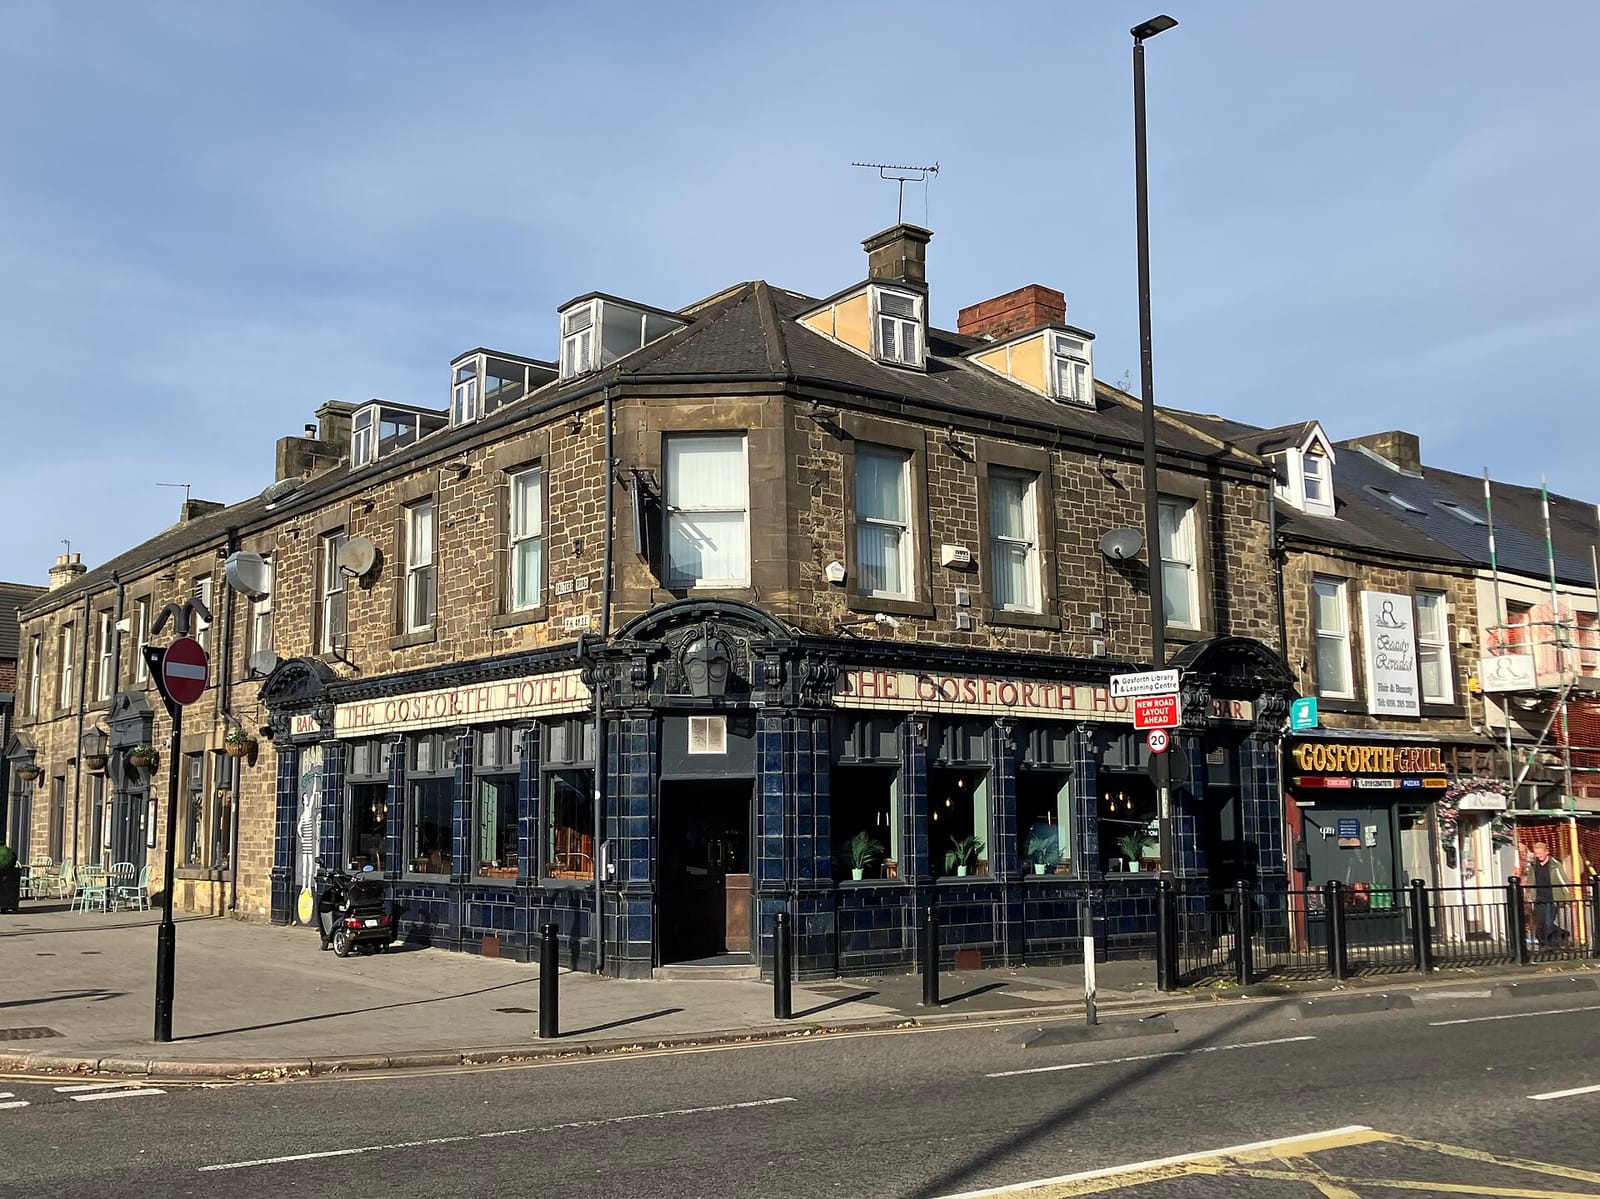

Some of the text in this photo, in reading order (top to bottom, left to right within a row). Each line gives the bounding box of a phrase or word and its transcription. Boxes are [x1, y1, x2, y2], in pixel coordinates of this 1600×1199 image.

[1122, 674, 1174, 685] Gosforth Library
[841, 671, 897, 698] THE
[916, 674, 1076, 709] GOSFORTH
[1126, 684, 1153, 693] Learning
[1154, 681, 1177, 689] Centre
[343, 676, 577, 728] THE GOSFORTH HOTEL
[1136, 699, 1174, 709] NEW ROAD
[1142, 708, 1169, 716] LAYOUT
[1212, 699, 1243, 719] BAR
[297, 714, 314, 732] BAR
[1144, 715, 1168, 724] AHEAD
[1151, 735, 1165, 746] 20
